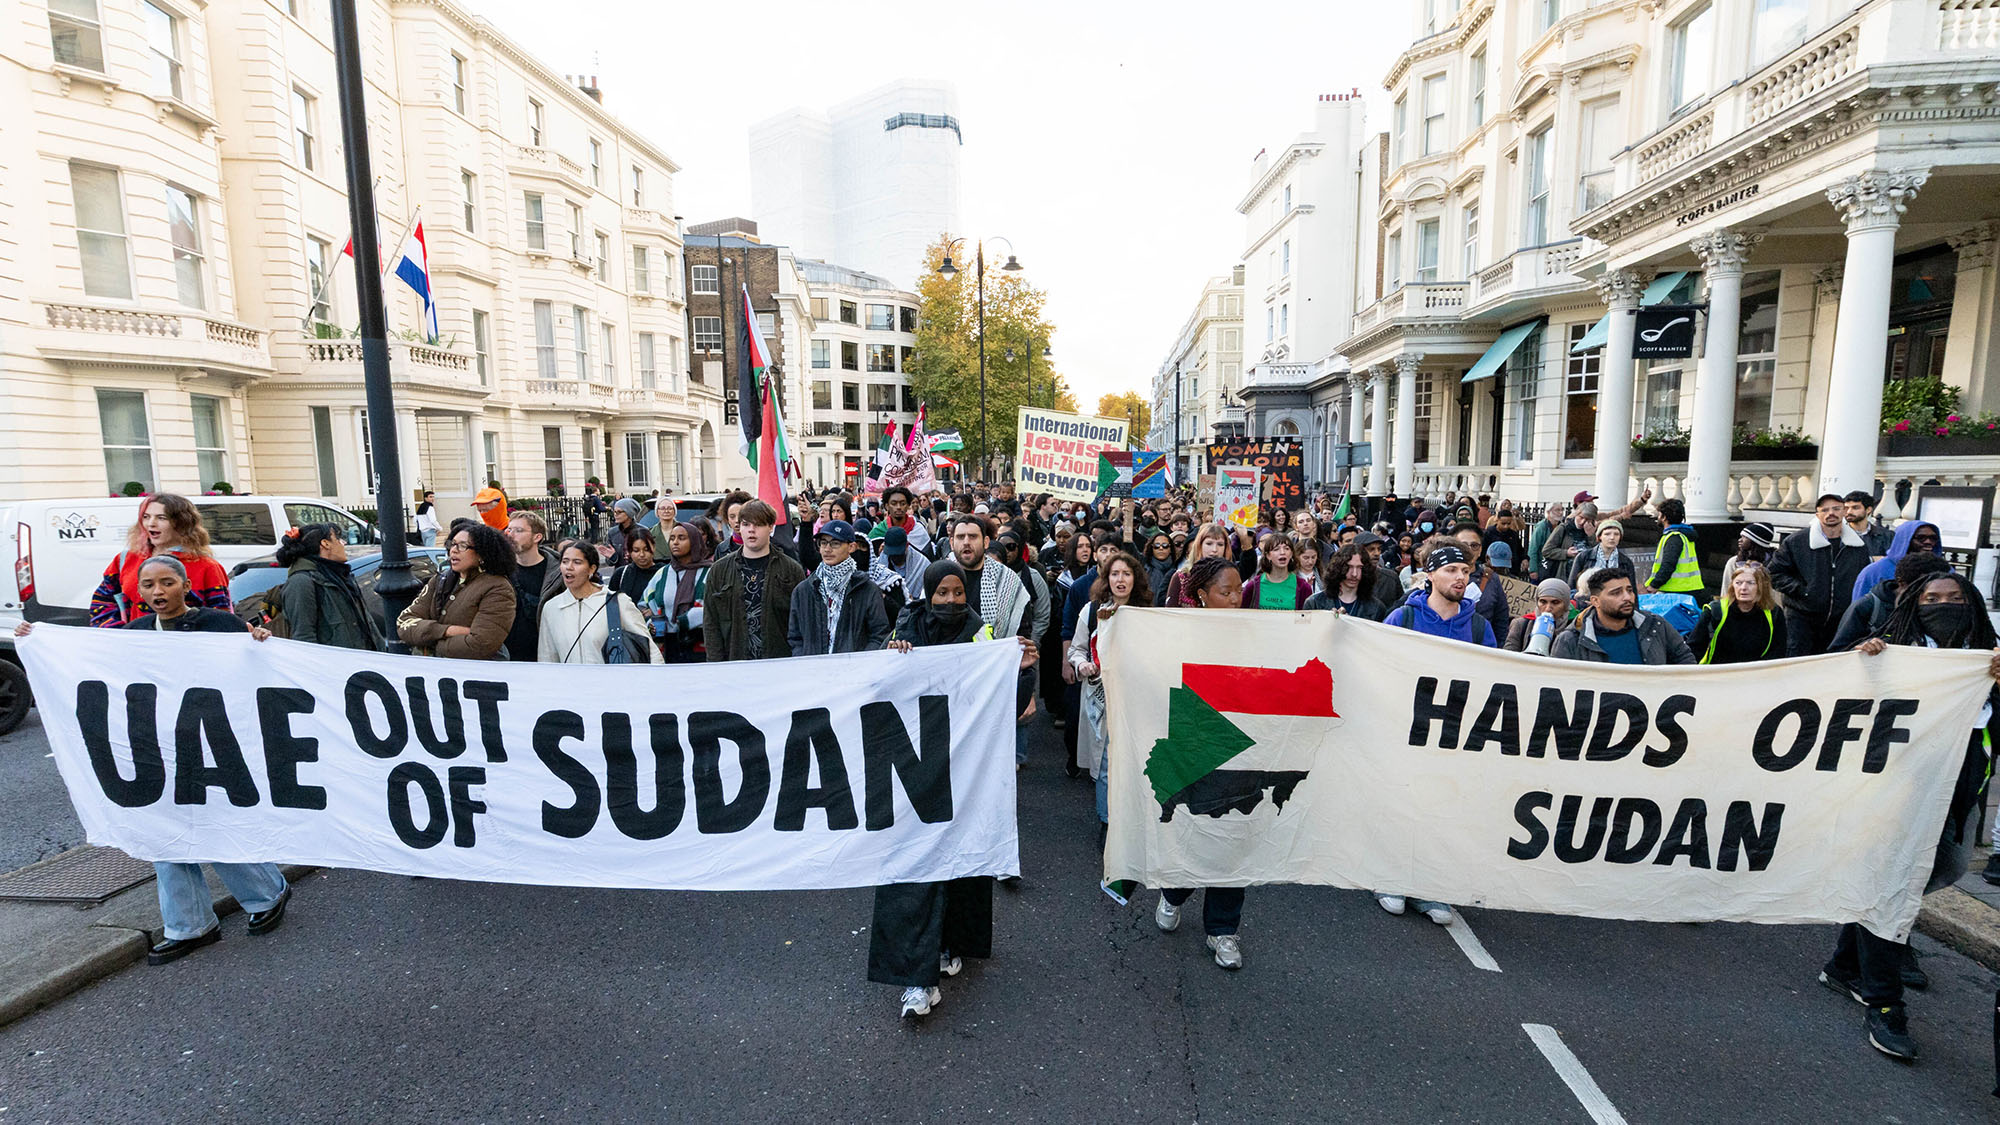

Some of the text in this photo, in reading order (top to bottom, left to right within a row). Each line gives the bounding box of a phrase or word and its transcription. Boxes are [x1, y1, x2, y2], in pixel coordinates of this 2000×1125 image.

[1024, 413, 1123, 443] International
[1023, 432, 1121, 459] Jewish
[1209, 442, 1290, 457] WOMEN
[1021, 448, 1099, 477] Anti-Zioni
[1210, 455, 1301, 468] COLOUR
[1020, 466, 1098, 493] Networ
[58, 528, 97, 540] NAT
[1407, 675, 1920, 774] HANDS OFF
[76, 670, 954, 850] UAE OUT OF SUDAN
[1506, 790, 1786, 872] SUDAN
